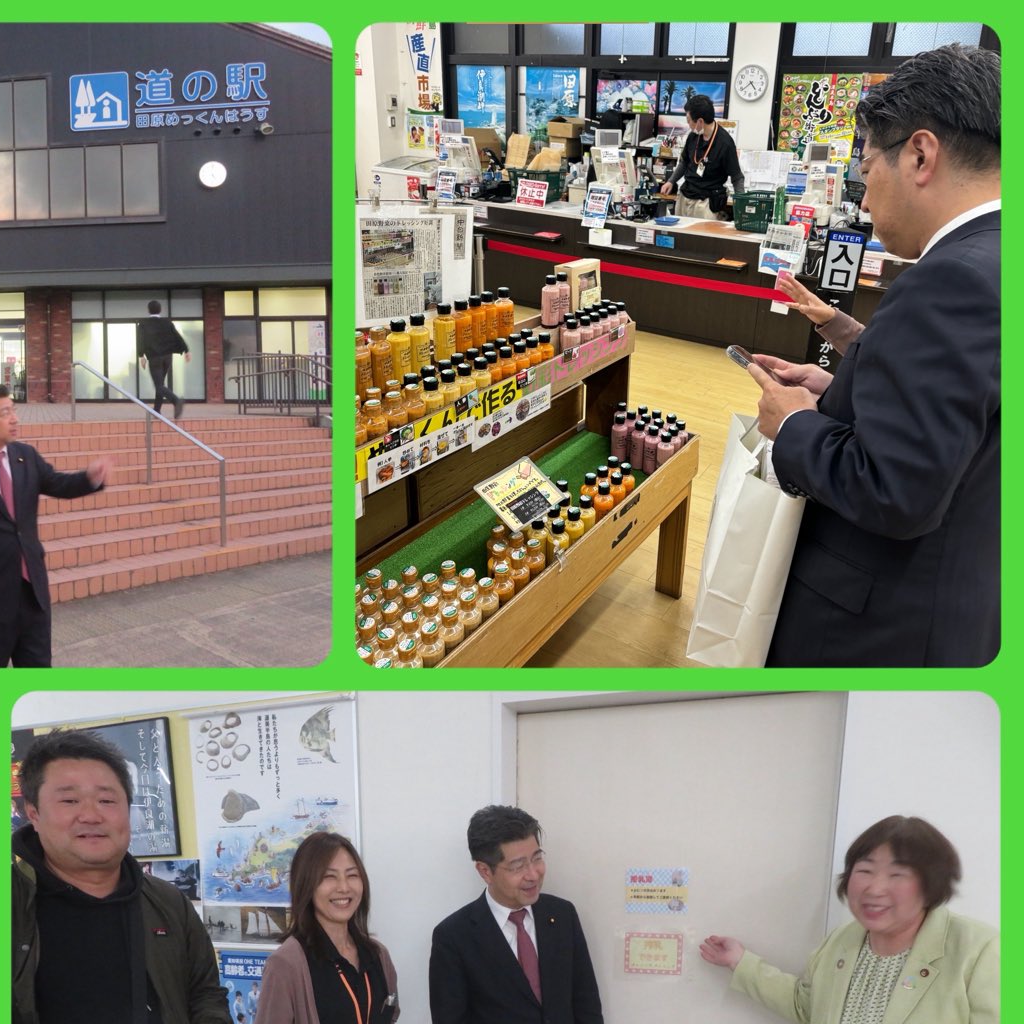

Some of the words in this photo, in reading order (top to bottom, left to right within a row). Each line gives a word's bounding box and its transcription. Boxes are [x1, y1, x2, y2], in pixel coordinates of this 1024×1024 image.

[135, 62, 268, 107] 道の駅
[135, 107, 269, 128] 田原めっくんはうす
[520, 187, 544, 199] 休止中
[832, 233, 862, 243] ENTER
[829, 245, 855, 288] 入口
